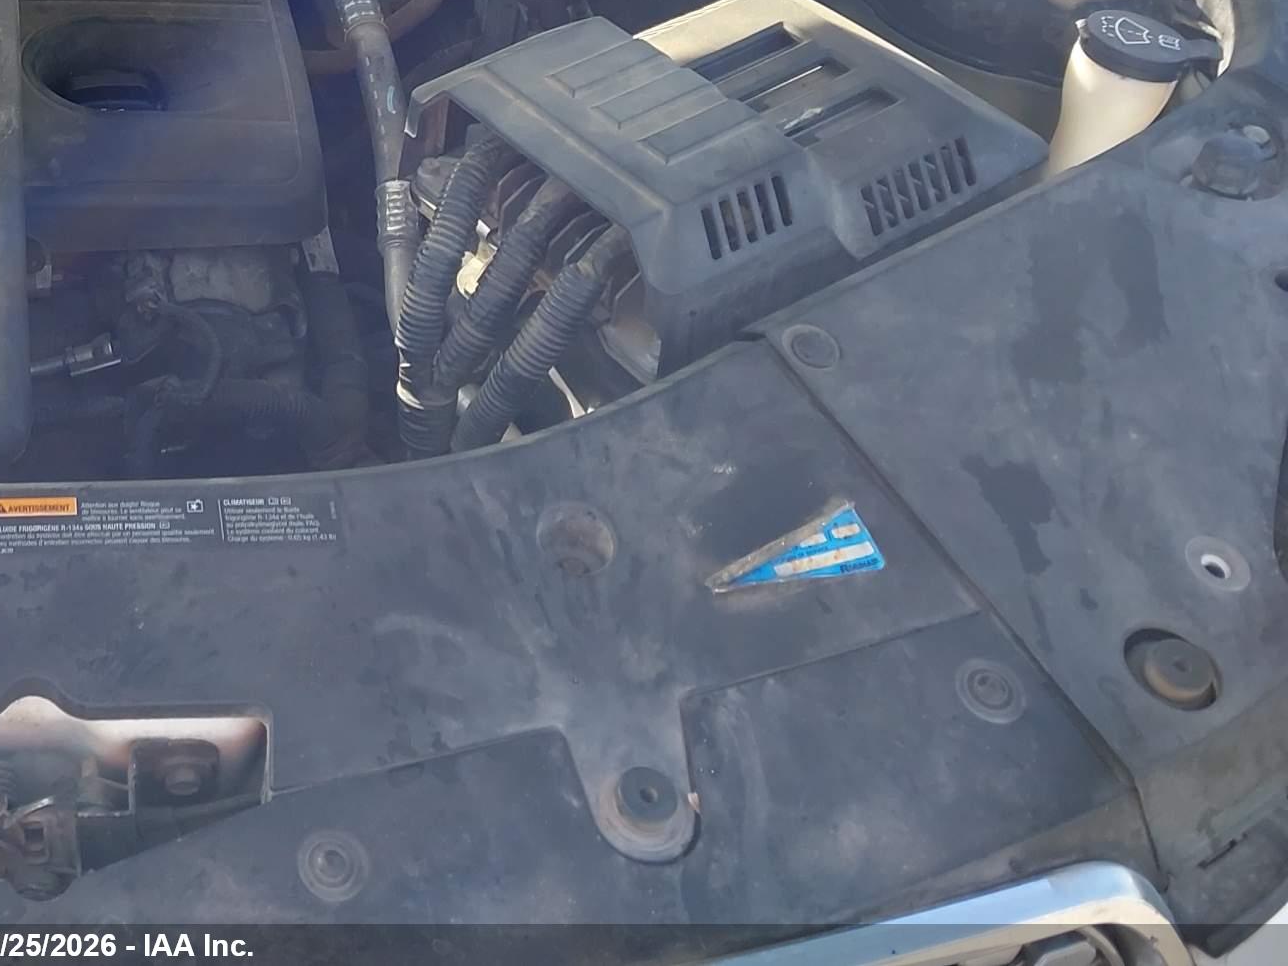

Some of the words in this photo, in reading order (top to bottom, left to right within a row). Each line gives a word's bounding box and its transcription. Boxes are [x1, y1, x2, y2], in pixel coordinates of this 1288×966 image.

[8, 504, 70, 513] AVERTISSEMENT
[85, 523, 102, 531] SOUS
[103, 523, 124, 531] HAUTE
[125, 522, 156, 530] PRESSION
